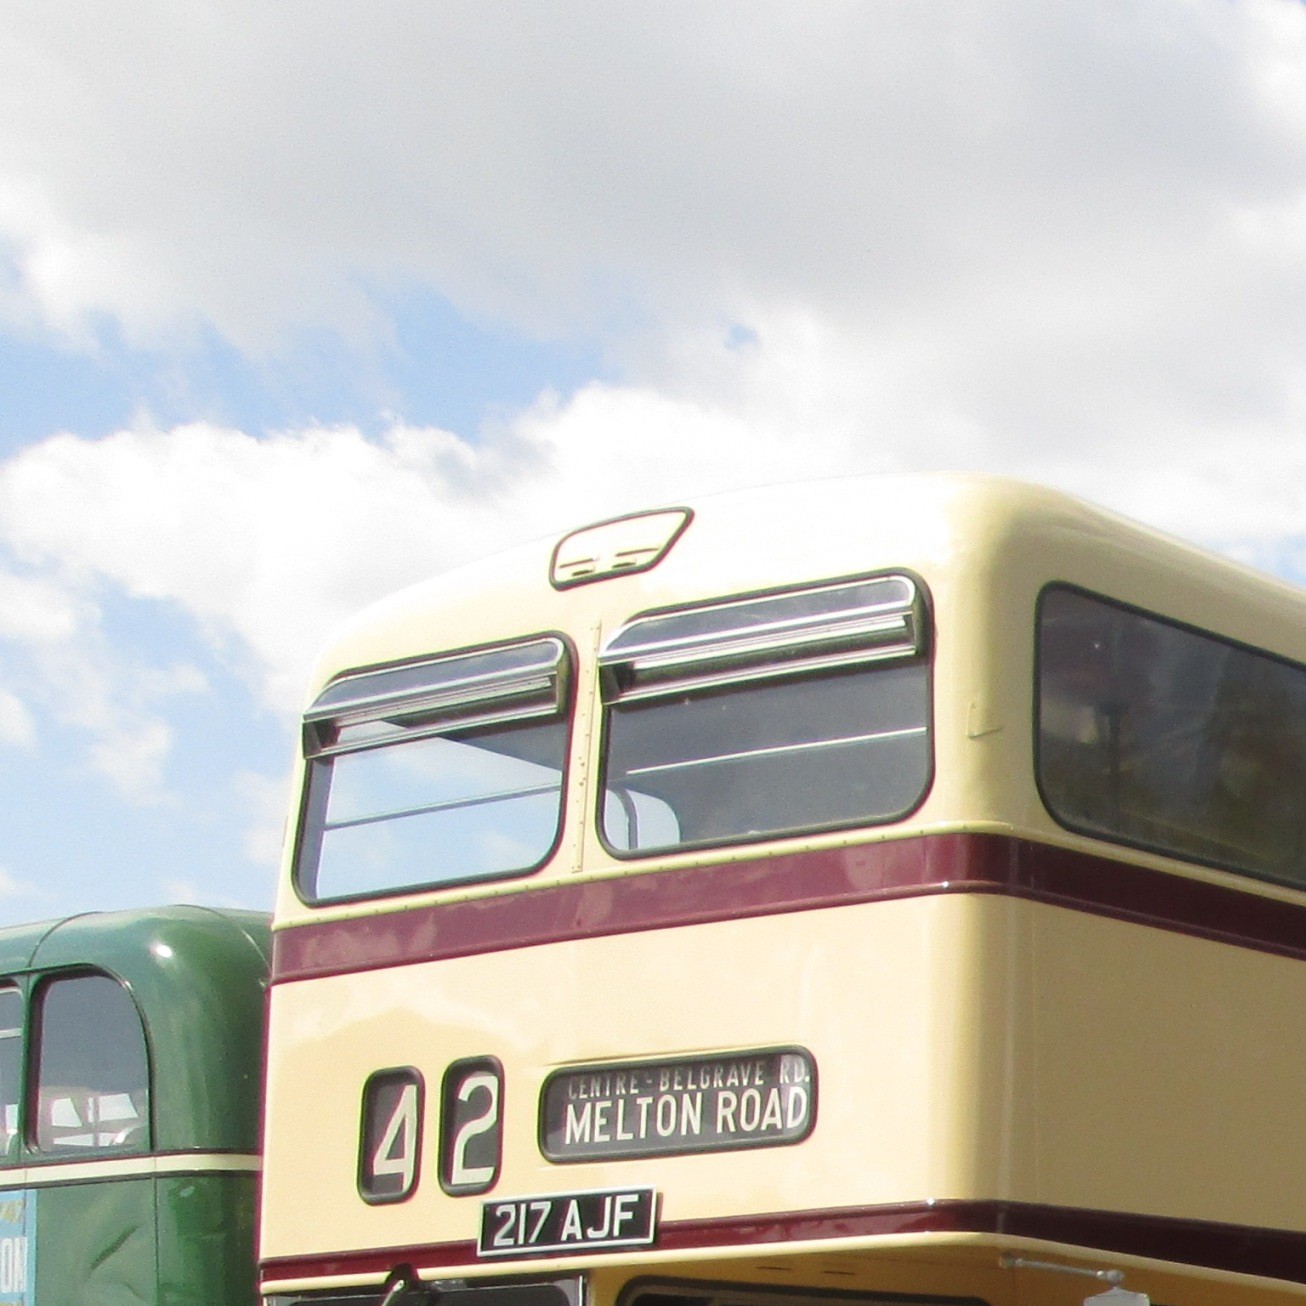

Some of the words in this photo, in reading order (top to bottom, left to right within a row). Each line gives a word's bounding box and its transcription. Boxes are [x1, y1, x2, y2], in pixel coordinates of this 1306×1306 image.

[659, 1061, 765, 1092] BELGRAVE
[565, 1092, 703, 1145] MELTON
[716, 1086, 808, 1134] ROAD
[494, 1202, 552, 1247] 217
[561, 1194, 639, 1240] AJF
